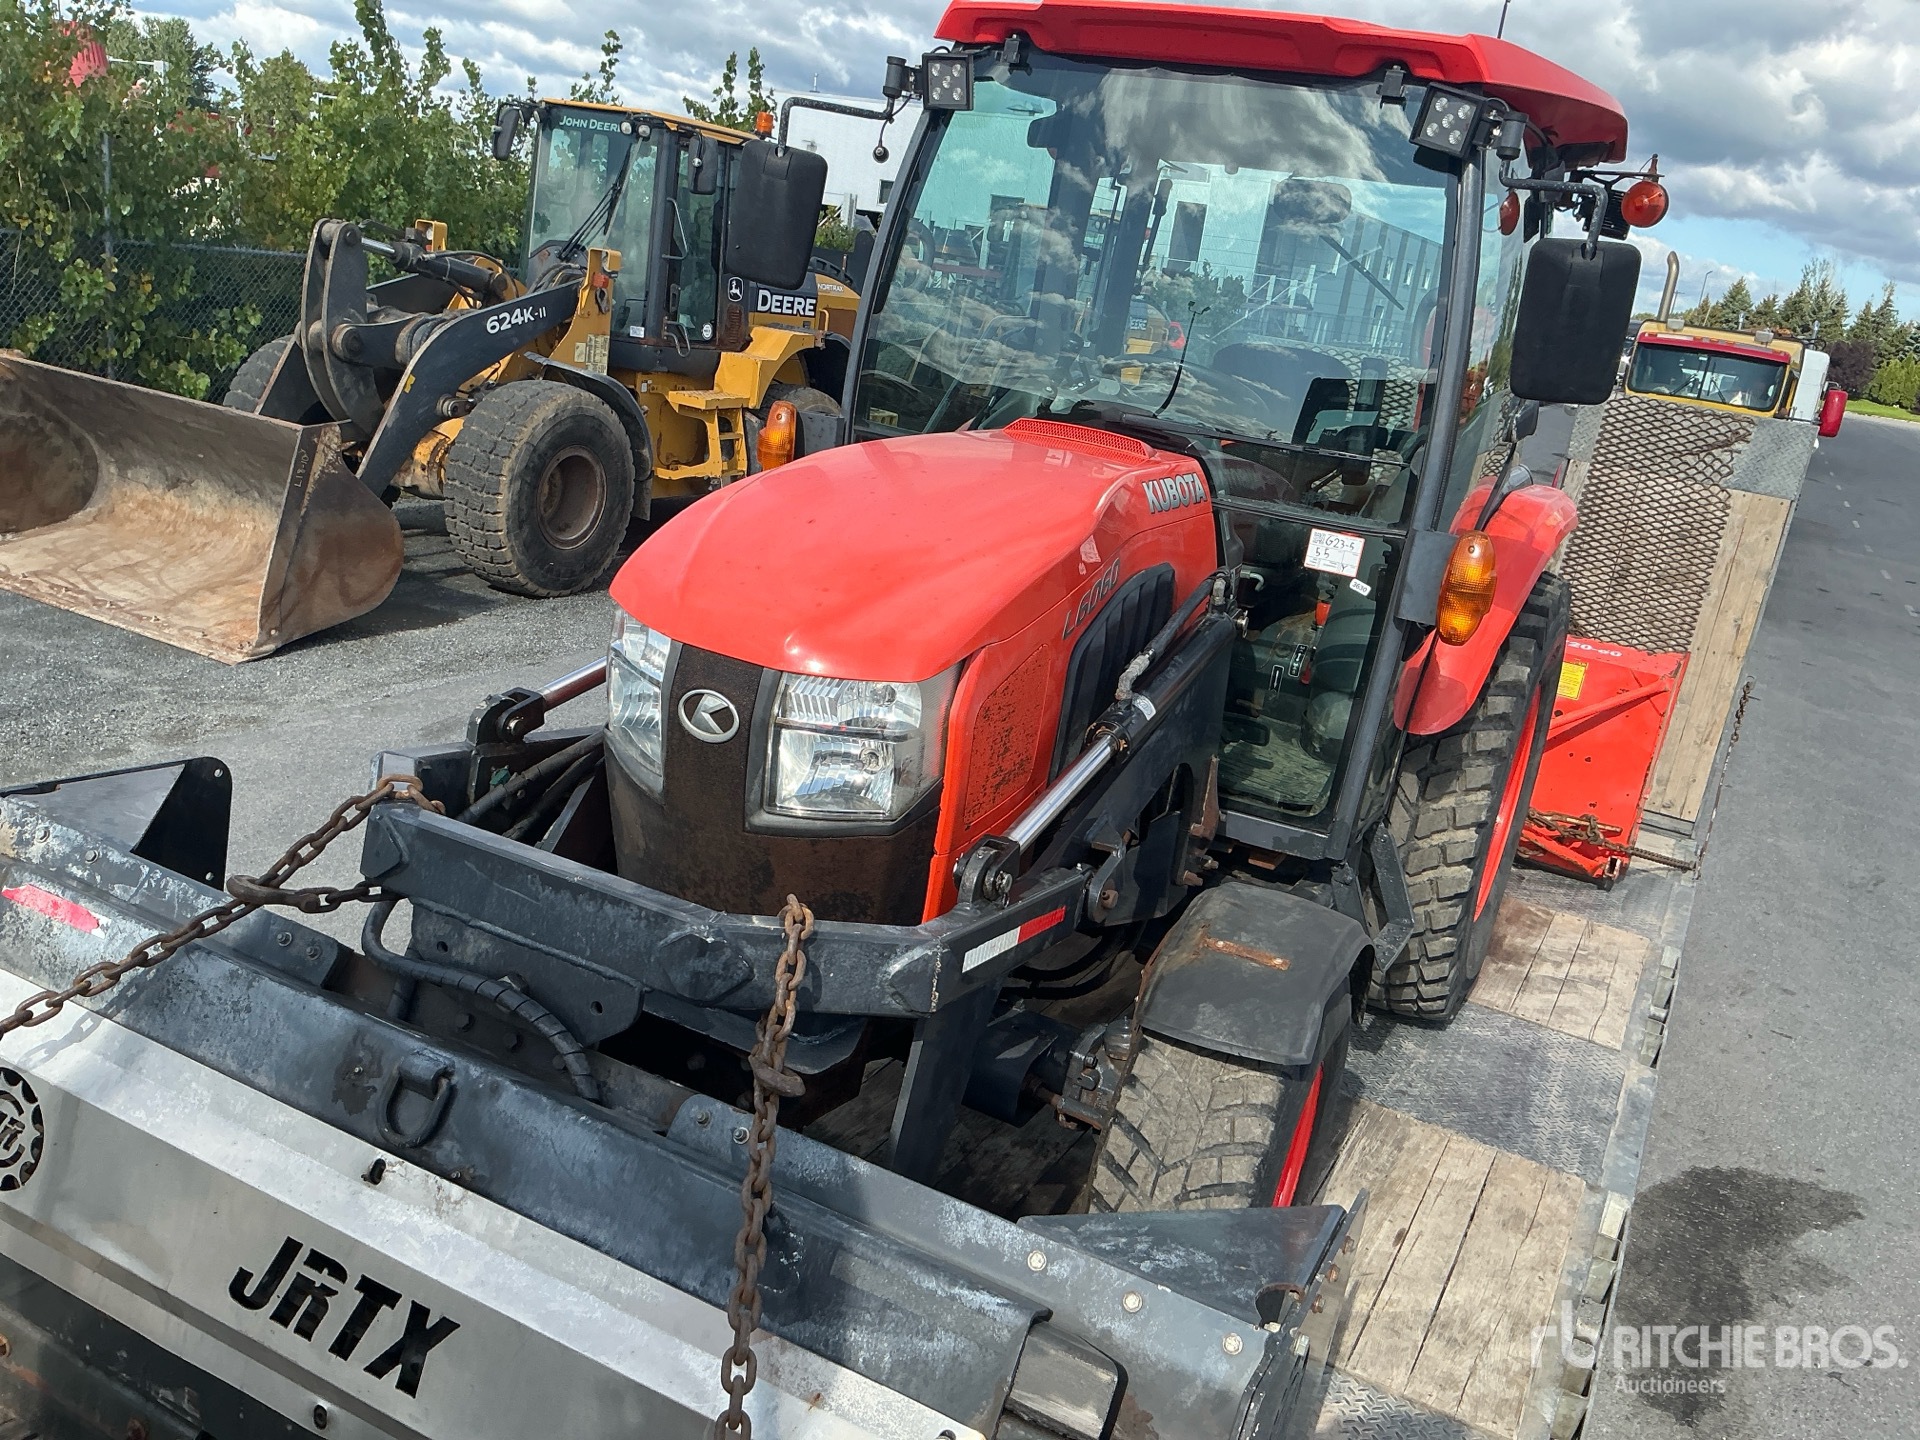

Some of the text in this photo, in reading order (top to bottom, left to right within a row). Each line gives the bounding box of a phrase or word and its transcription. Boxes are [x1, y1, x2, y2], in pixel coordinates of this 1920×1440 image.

[559, 115, 587, 129] JOHN
[757, 289, 817, 316] DEERE
[1142, 472, 1207, 514] KUBOTA
[1062, 557, 1120, 640] L6060
[228, 1235, 461, 1399] JRTX
